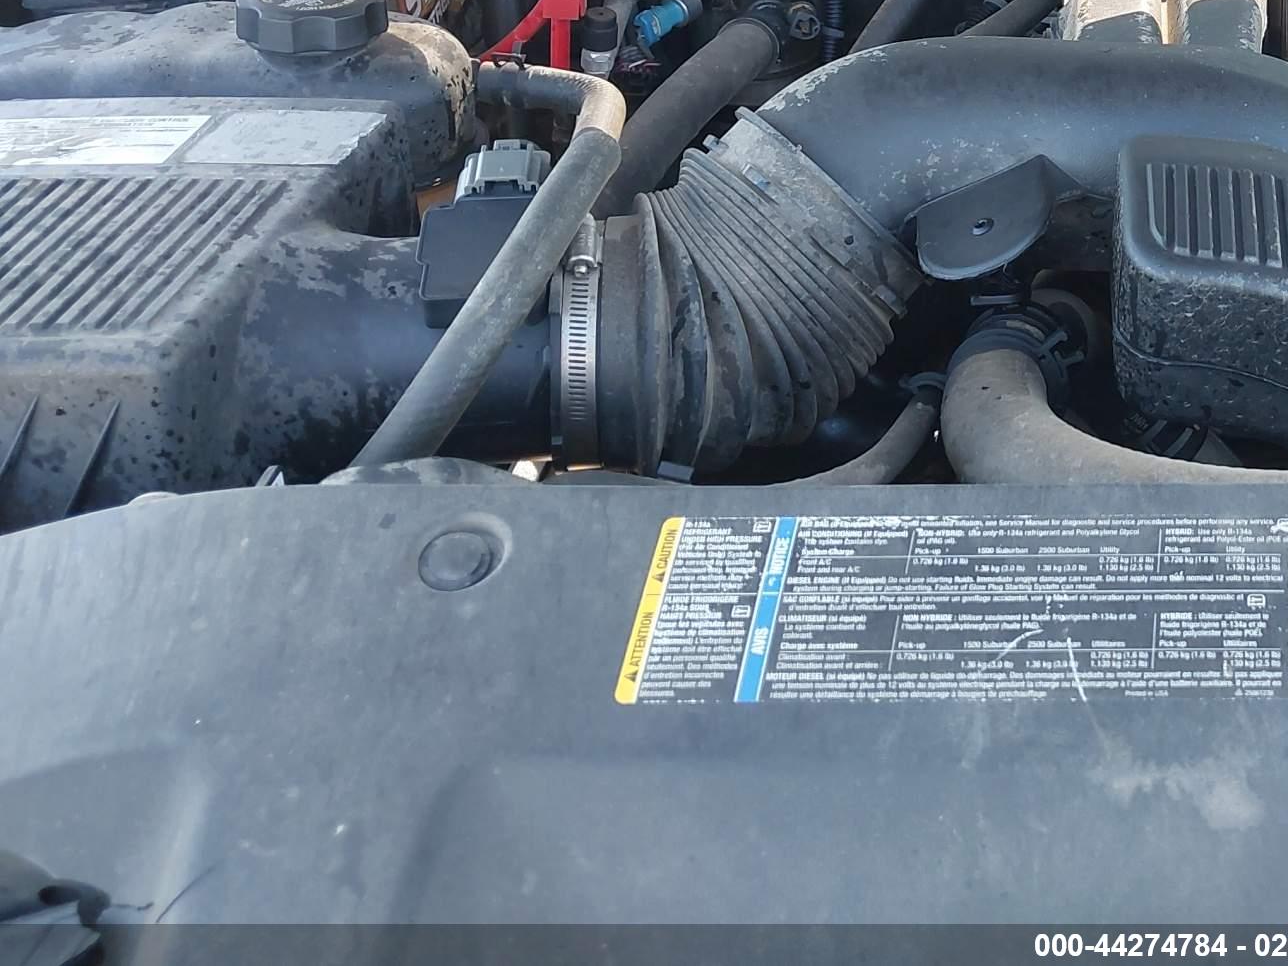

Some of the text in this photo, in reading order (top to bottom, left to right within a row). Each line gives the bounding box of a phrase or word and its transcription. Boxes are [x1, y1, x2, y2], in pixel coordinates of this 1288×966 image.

[656, 528, 678, 570] CAUTION
[771, 536, 791, 574] NOTICE
[631, 611, 655, 667] ATTENTION
[750, 627, 769, 655] AVIS
